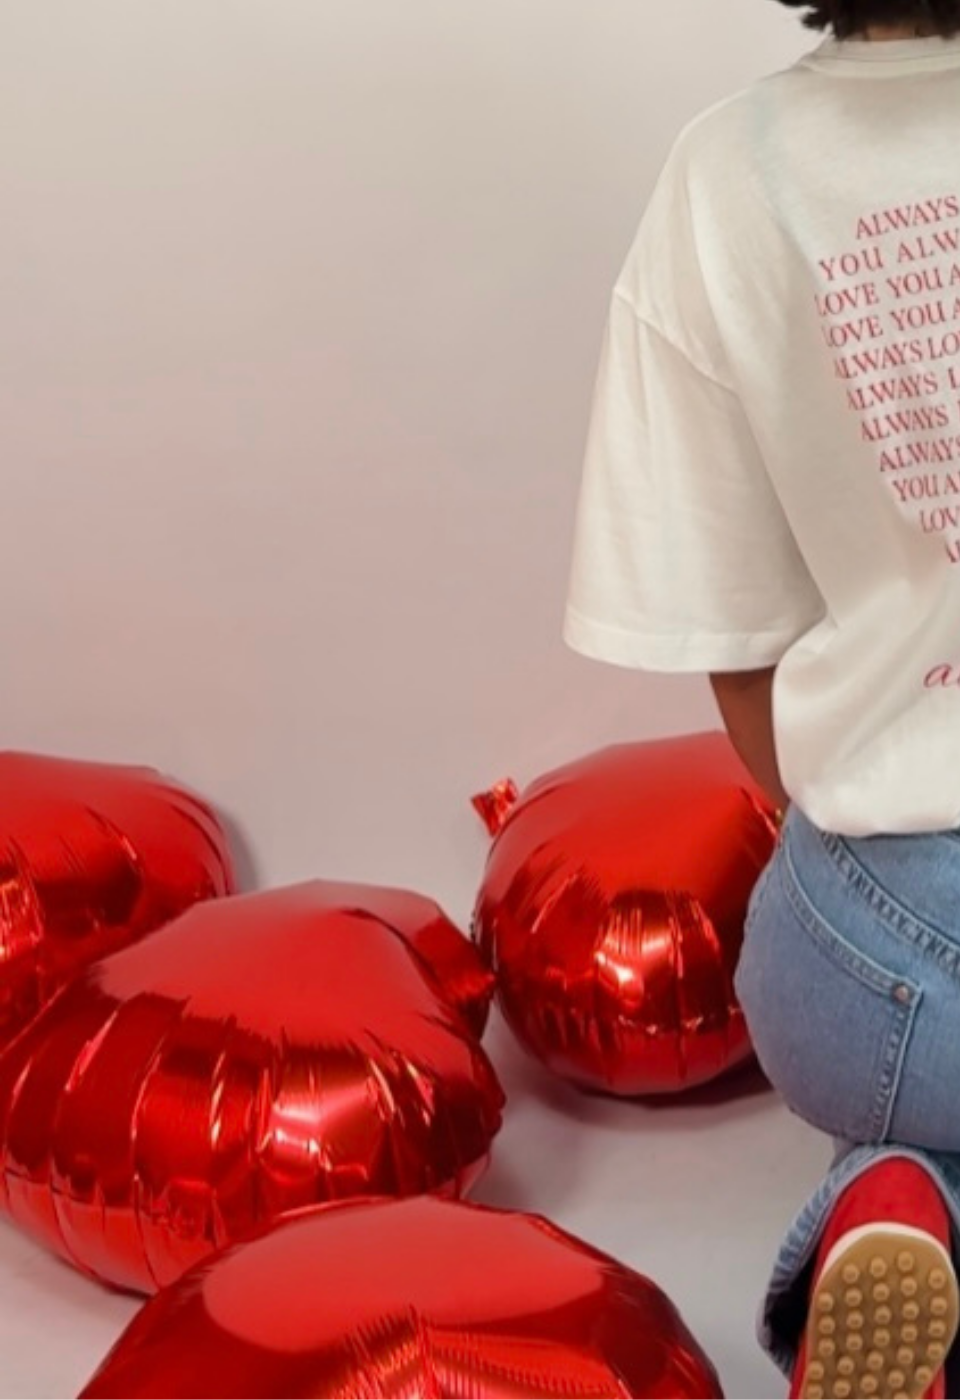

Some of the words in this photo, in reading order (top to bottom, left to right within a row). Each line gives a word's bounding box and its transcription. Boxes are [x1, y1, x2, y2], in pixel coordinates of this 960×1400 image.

[856, 195, 960, 240] ALWAYS
[819, 246, 884, 282] YOU
[814, 282, 879, 317] LOVE
[886, 267, 943, 299] YOU
[890, 300, 946, 331] YOU
[861, 404, 949, 442] ALWAYS
[892, 474, 940, 503] YOU
